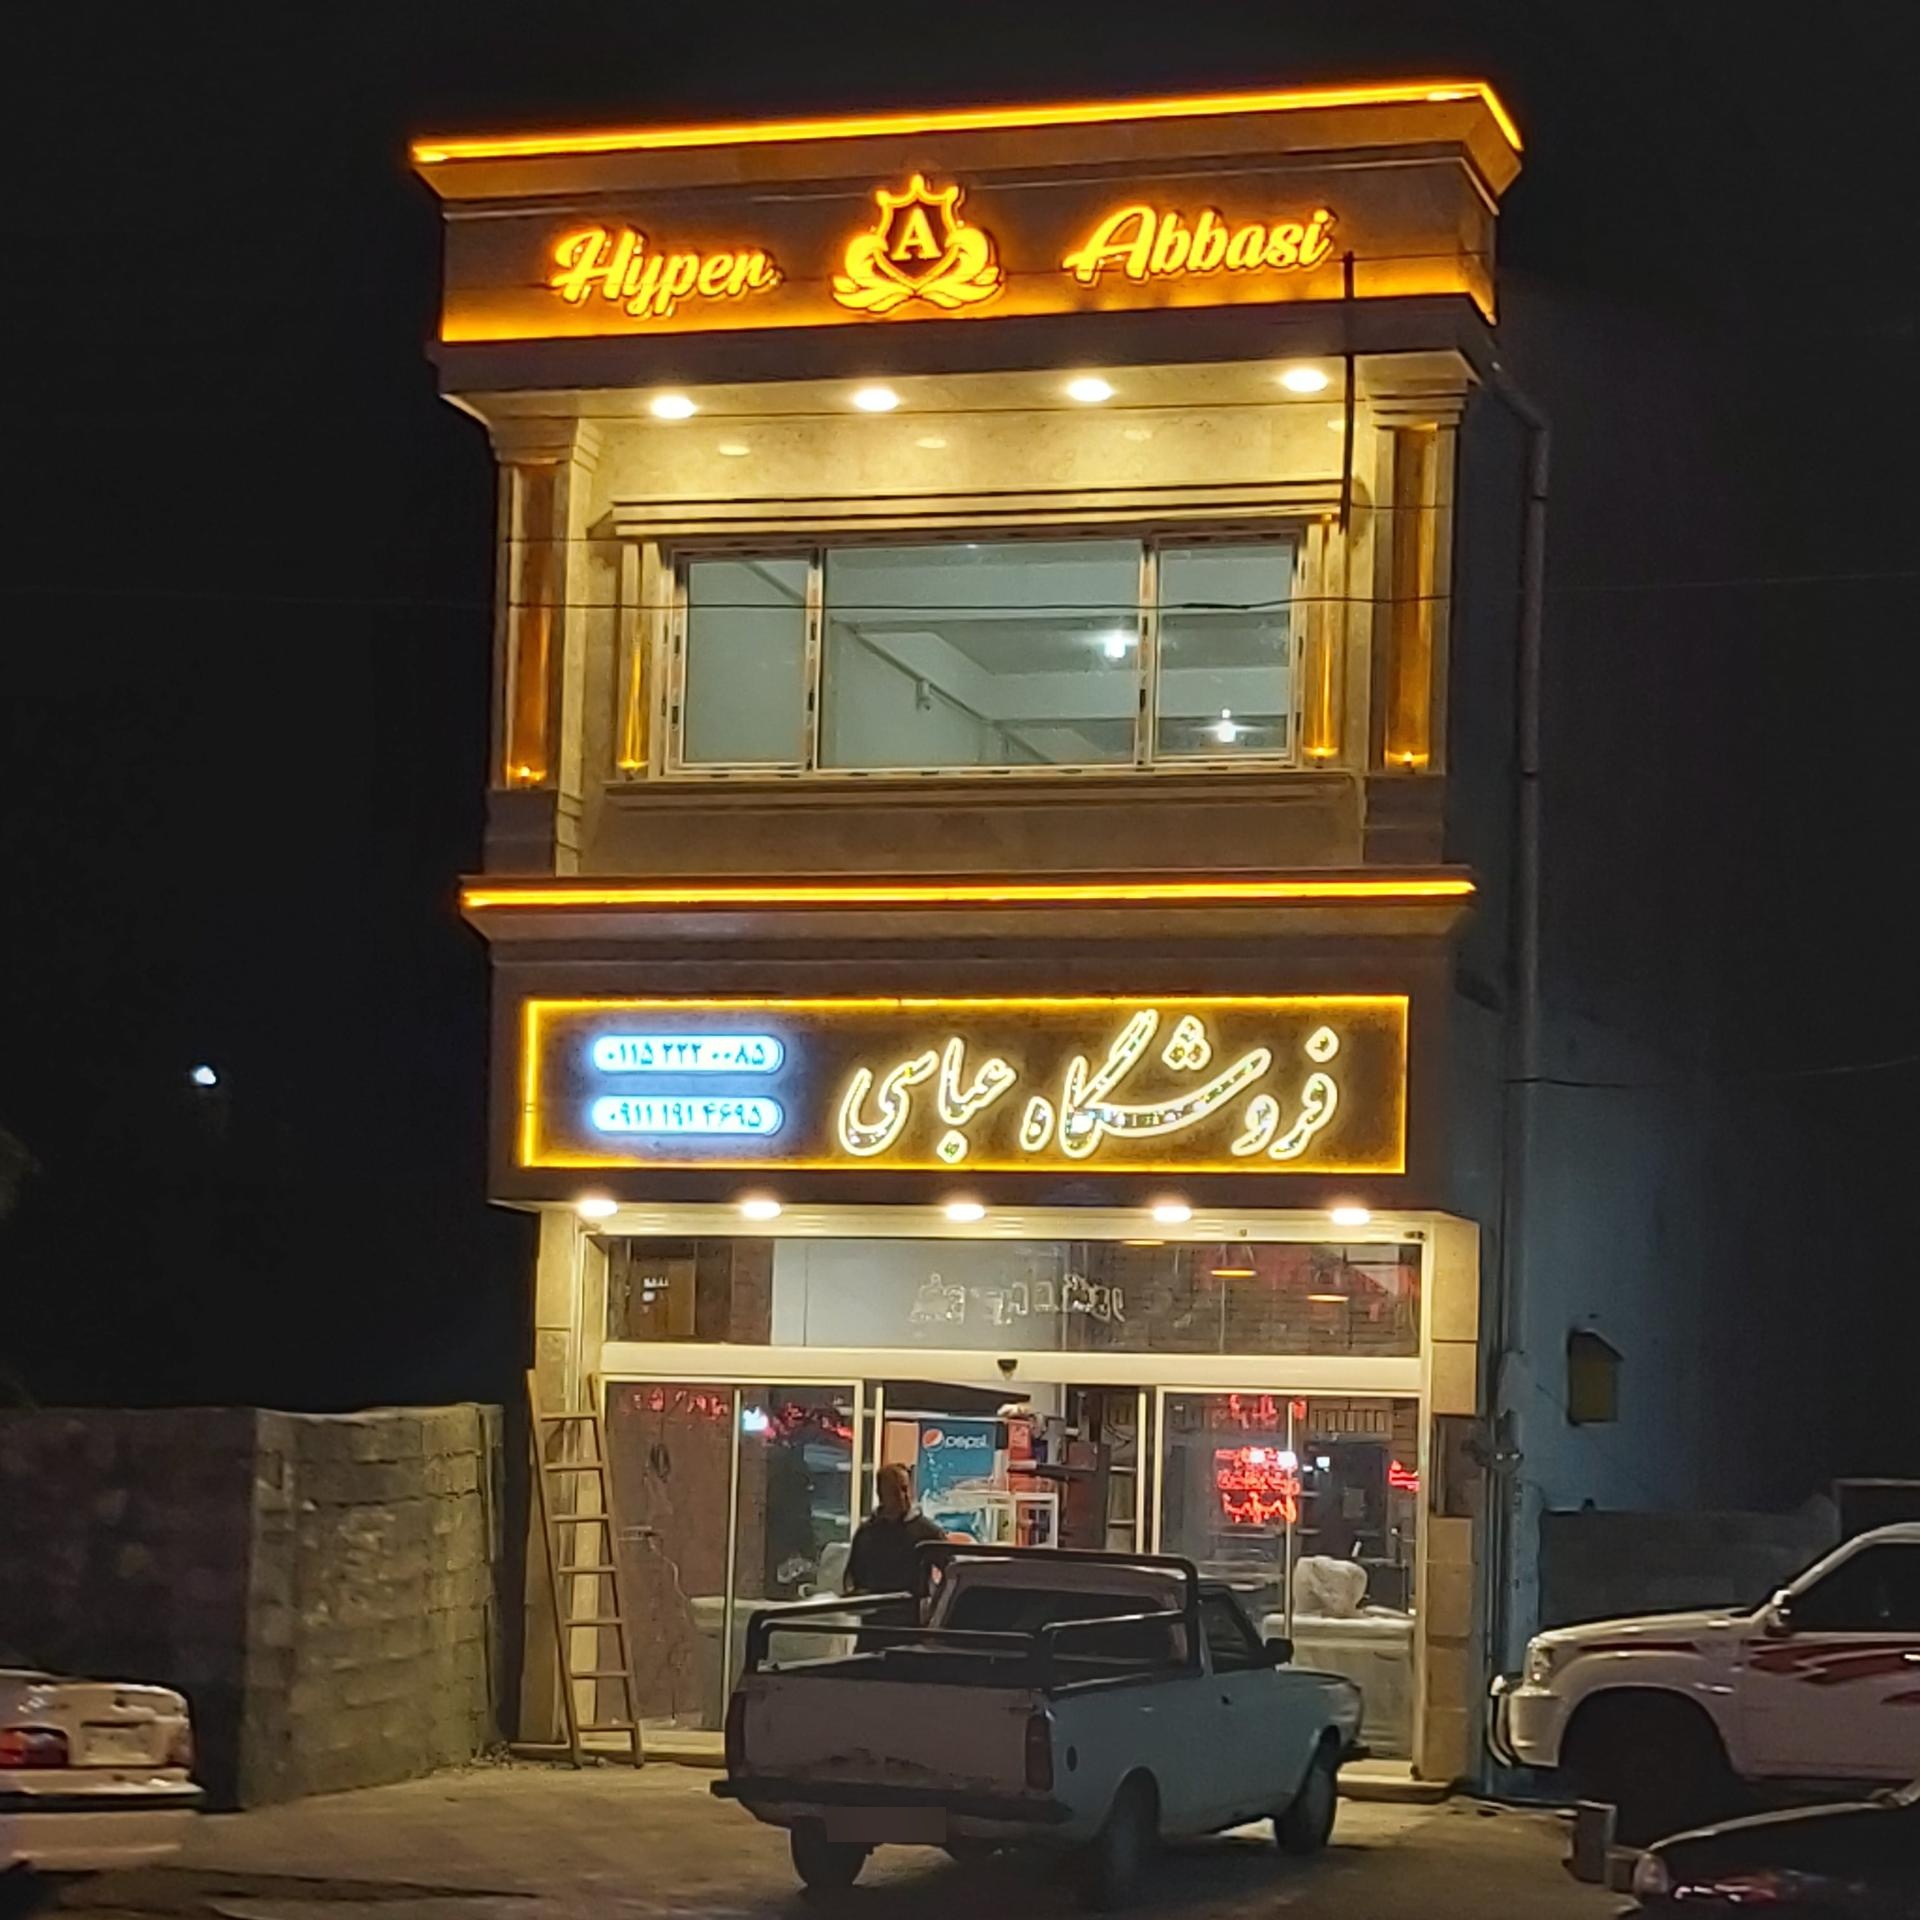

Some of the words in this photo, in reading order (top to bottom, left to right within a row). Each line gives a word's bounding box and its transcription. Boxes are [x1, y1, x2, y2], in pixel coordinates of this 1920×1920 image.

[550, 229, 778, 316] Hyper
[1062, 205, 1332, 282] Abbasi
[890, 206, 942, 261] A
[839, 1036, 1018, 1163] عباسی
[1020, 1009, 1338, 1160] فروشگاه
